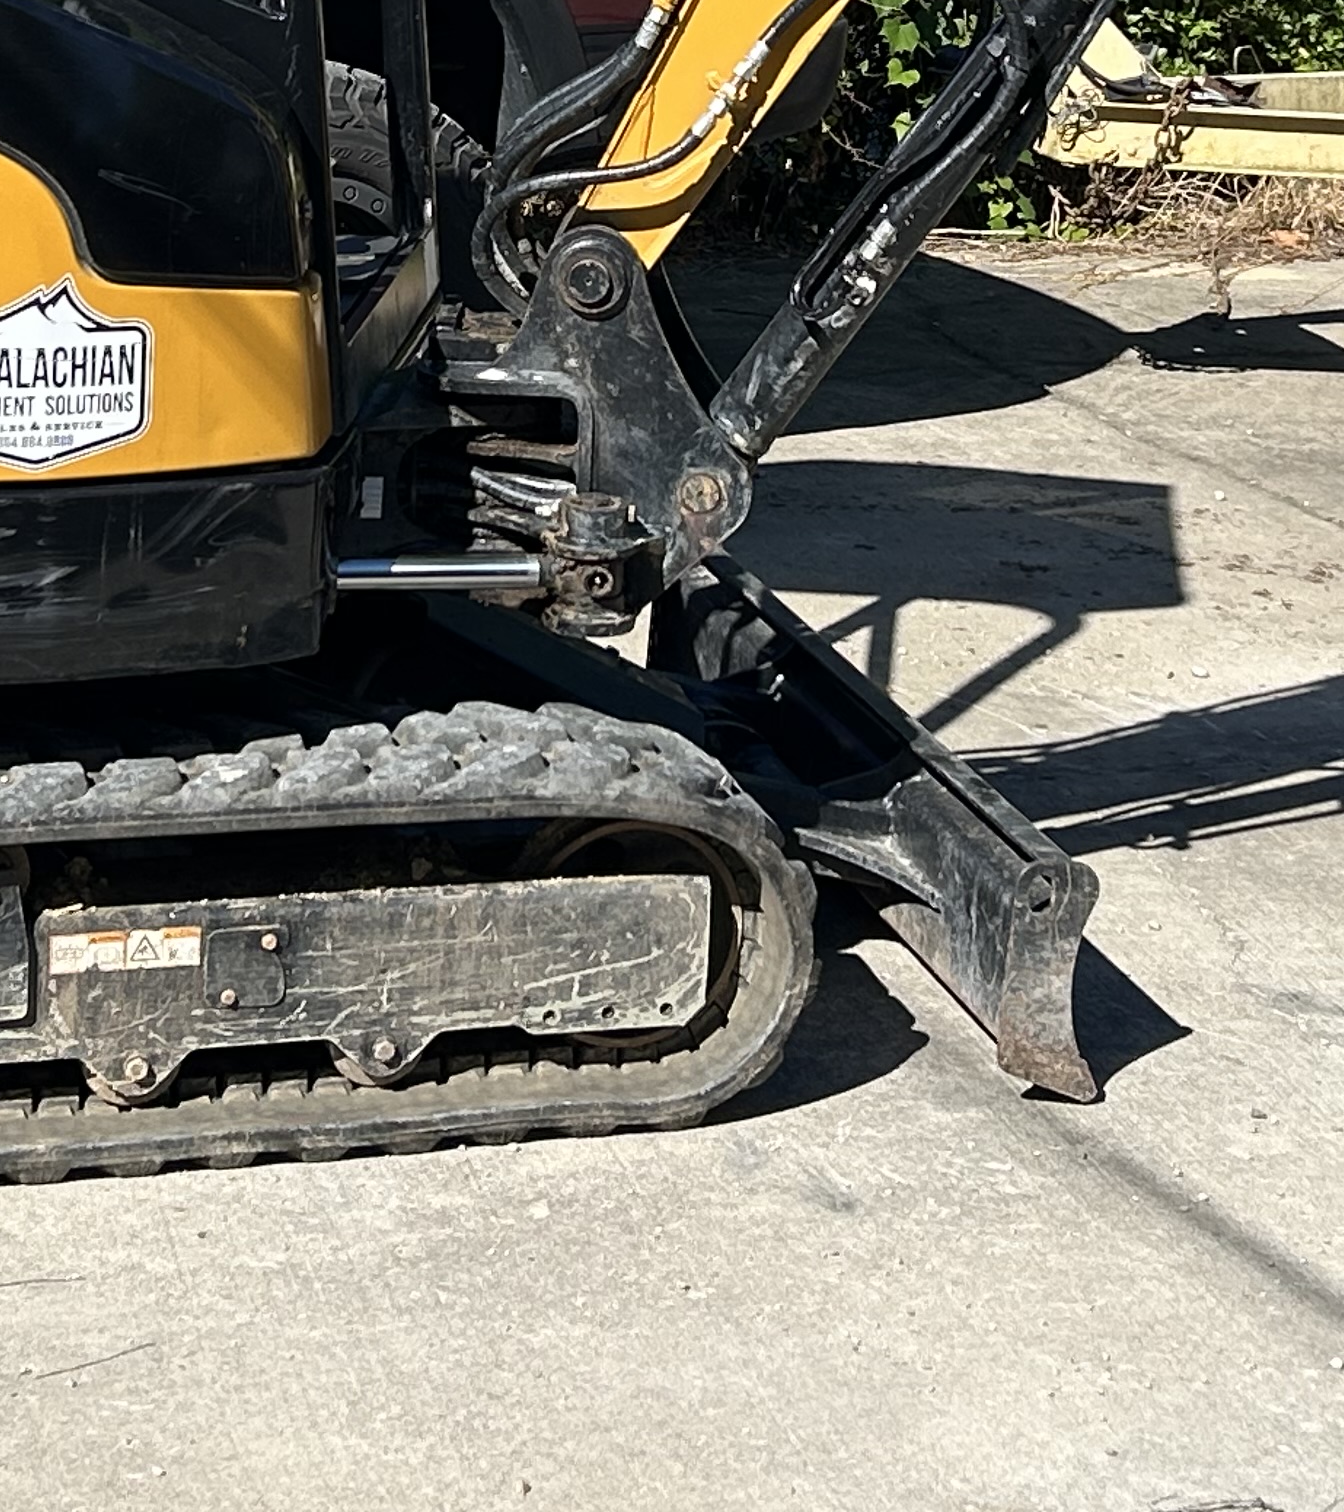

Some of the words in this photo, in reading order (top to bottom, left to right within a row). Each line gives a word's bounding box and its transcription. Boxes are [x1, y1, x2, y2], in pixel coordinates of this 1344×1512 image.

[45, 392, 135, 416] SOLUTIONS
[30, 421, 41, 431] &
[45, 421, 104, 432] SERVICE
